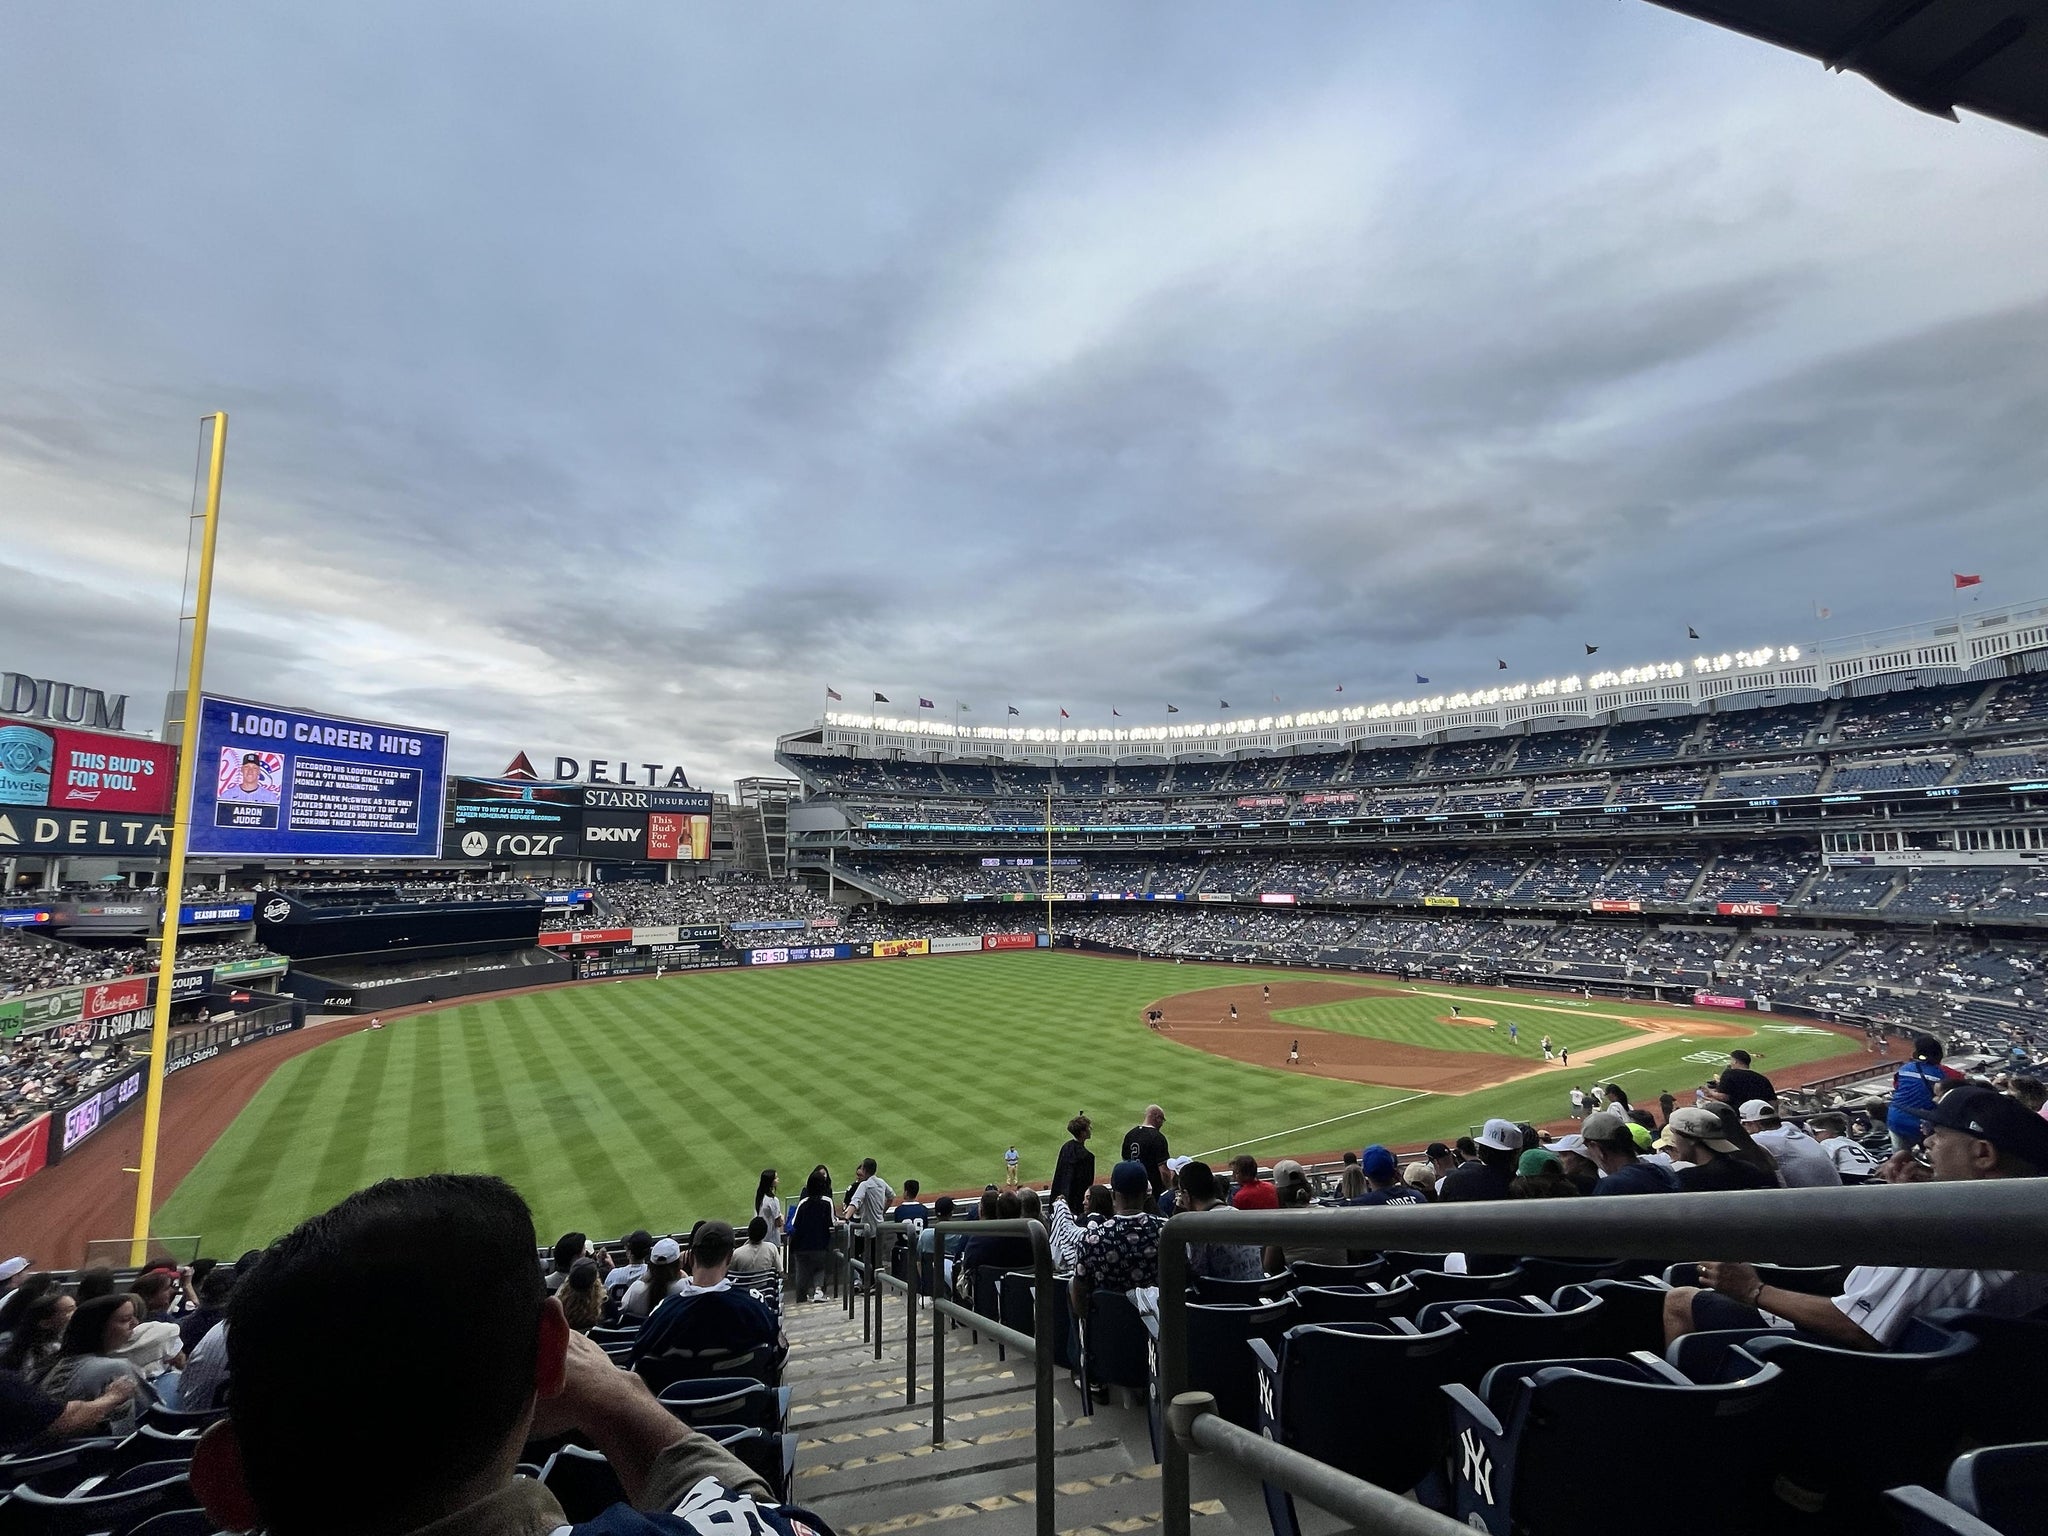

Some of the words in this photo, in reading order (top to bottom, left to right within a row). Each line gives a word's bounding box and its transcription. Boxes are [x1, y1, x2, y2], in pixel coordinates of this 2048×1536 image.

[294, 722, 373, 751] CAREER
[379, 735, 422, 756] HITS
[71, 751, 106, 770] THIS
[108, 756, 155, 776] BUD'S
[296, 762, 332, 772] RECORDED
[374, 770, 399, 778] CAREER
[296, 770, 314, 778] WITH
[338, 774, 360, 782] INNING
[361, 776, 384, 784] SINGLE
[554, 756, 690, 788] DELTA
[68, 770, 100, 788] FOR
[102, 774, 137, 791] YOU.
[295, 778, 323, 787] MONDAY
[293, 801, 323, 809] PLAYERS
[584, 790, 649, 808] STARR
[654, 797, 709, 807] INSURANCE
[232, 807, 262, 817] AARON
[232, 816, 262, 825] JUDGE
[292, 818, 330, 826] RECORDING
[652, 816, 672, 824] This
[34, 818, 167, 846] DELTA
[652, 824, 676, 832] Bud's
[586, 828, 642, 842] DKNY
[652, 832, 667, 841] For
[496, 835, 563, 856] razr
[652, 840, 671, 848] You.
[104, 906, 143, 914] TERRACE
[194, 910, 217, 920] SEASON
[218, 909, 240, 918] TICKETS
[1731, 904, 1763, 914] AVIS
[810, 948, 835, 959] $9,239
[172, 976, 202, 989] coupa
[99, 1020, 108, 1040] A
[110, 1013, 132, 1036] SUB
[275, 1023, 292, 1032] CLEAR
[1130, 1142, 1140, 1162] 2
[1258, 1368, 1274, 1420] NY
[1460, 1428, 1494, 1505] NY
